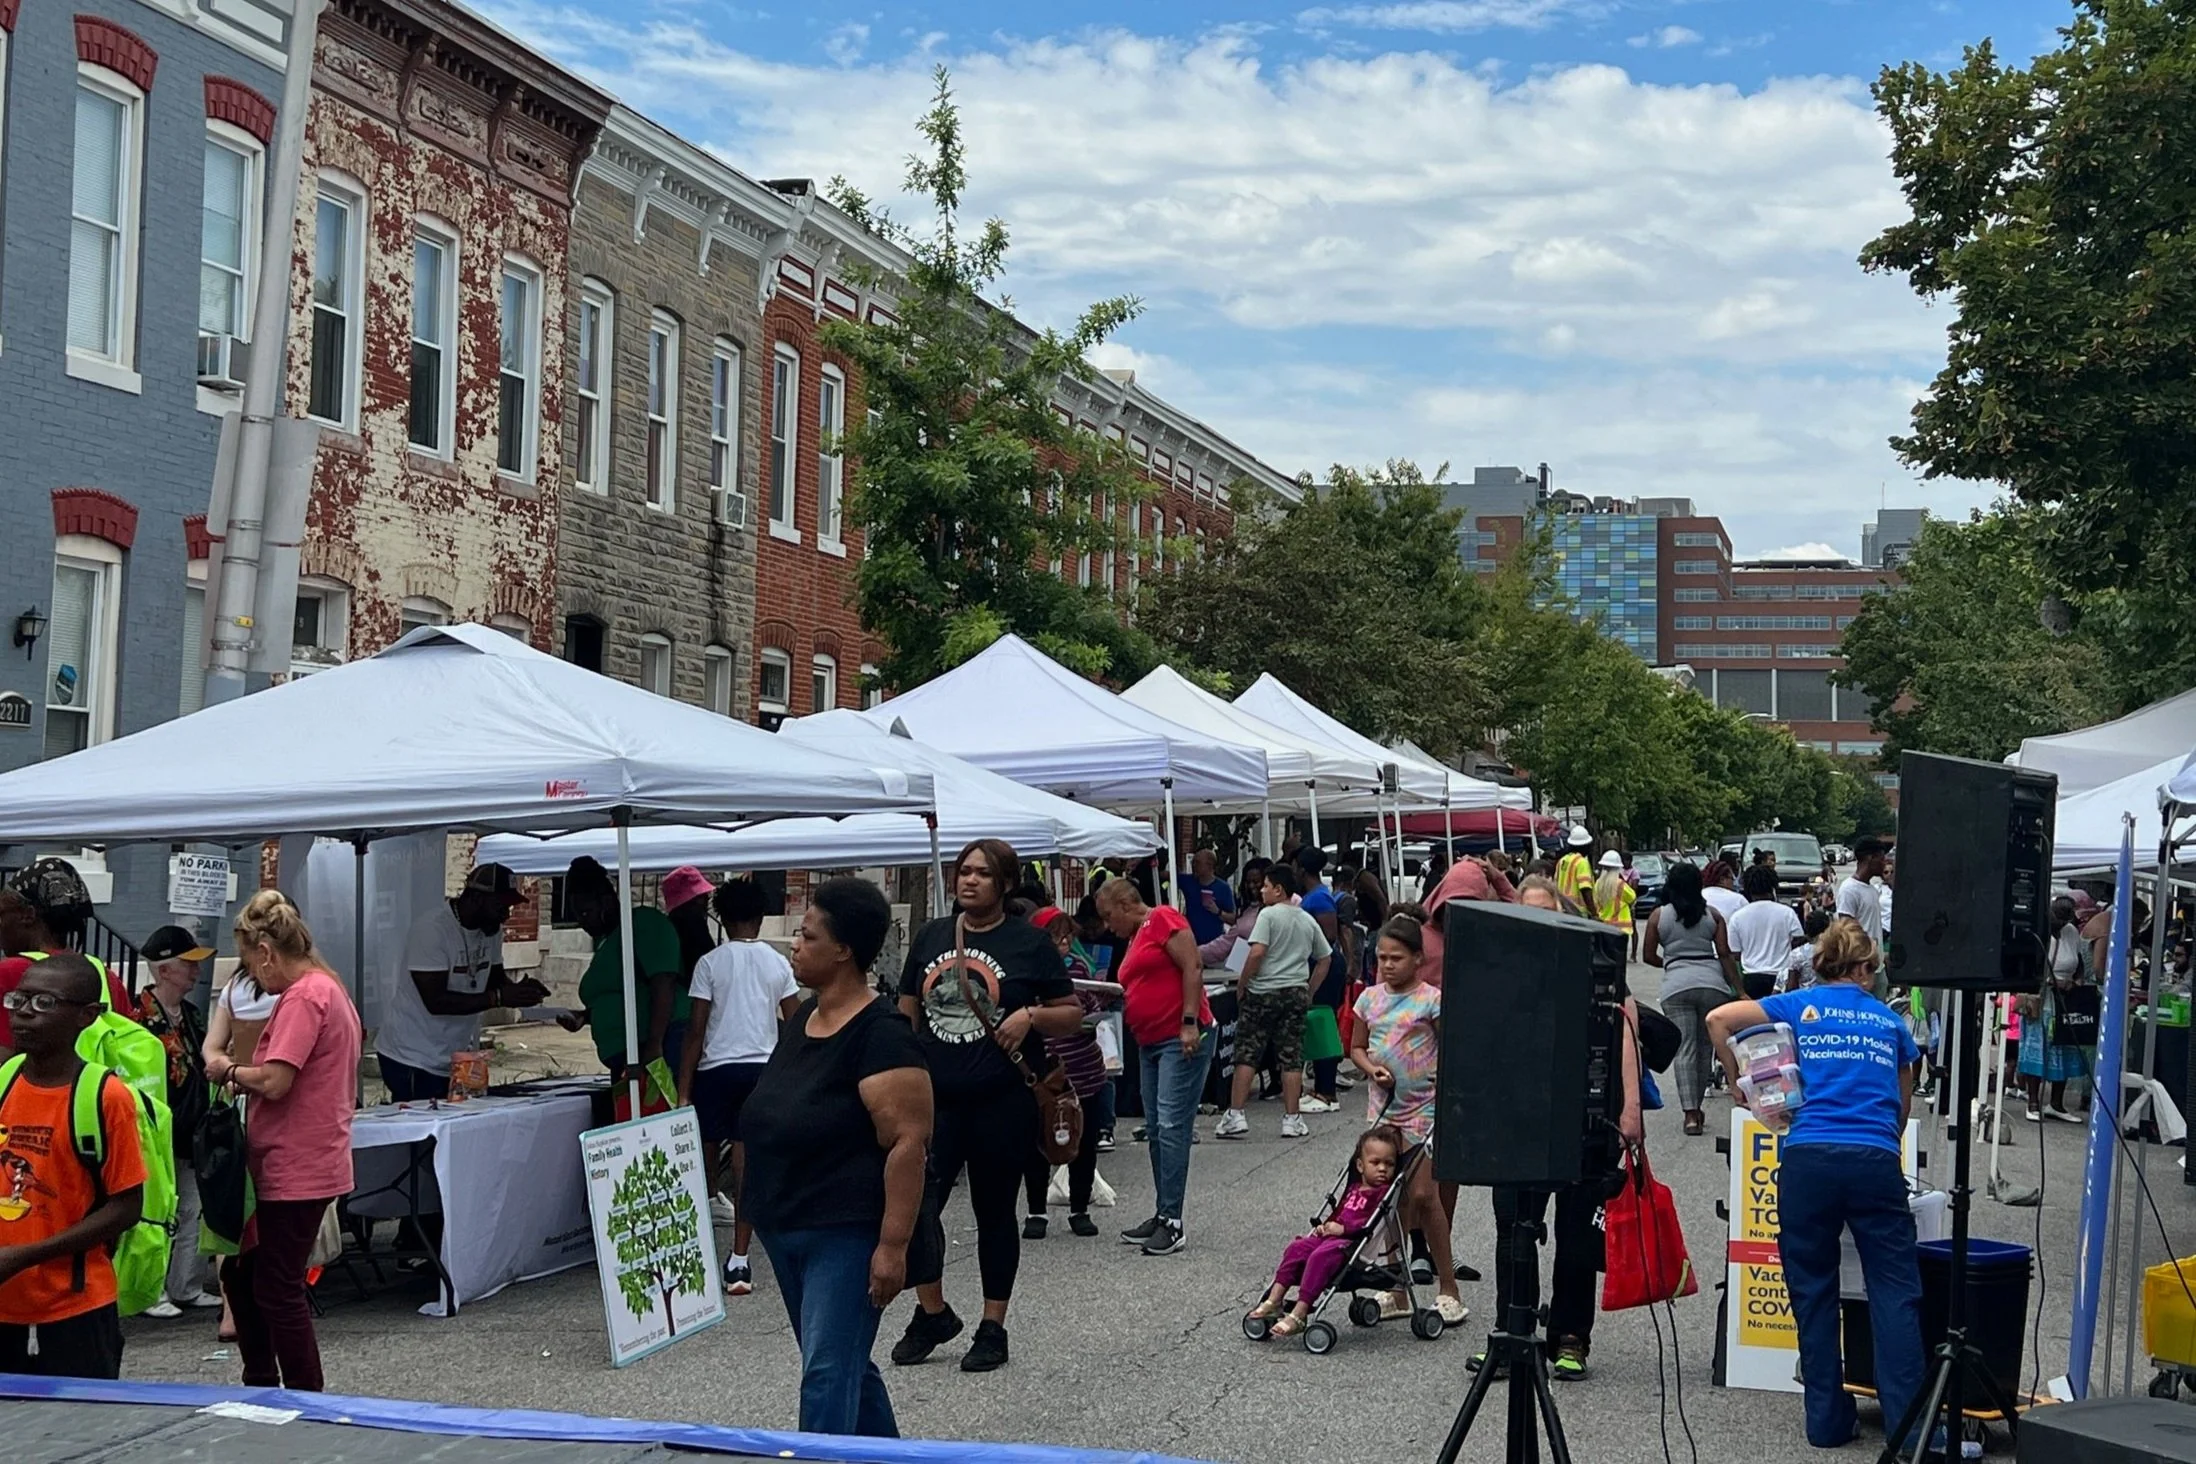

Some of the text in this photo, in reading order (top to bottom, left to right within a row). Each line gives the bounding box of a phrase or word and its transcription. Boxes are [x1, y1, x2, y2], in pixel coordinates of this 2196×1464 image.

[0, 702, 26, 721] 2217
[179, 857, 194, 868] NO
[924, 960, 937, 975] IN
[1822, 1007, 1897, 1029] JOHNS HOPKINS
[1798, 1034, 1860, 1046] COVID-19
[1801, 1048, 1894, 1068] Vaccination Team
[606, 1145, 623, 1159] Health
[1749, 1229, 1765, 1238] No
[1747, 1319, 1763, 1329] No
